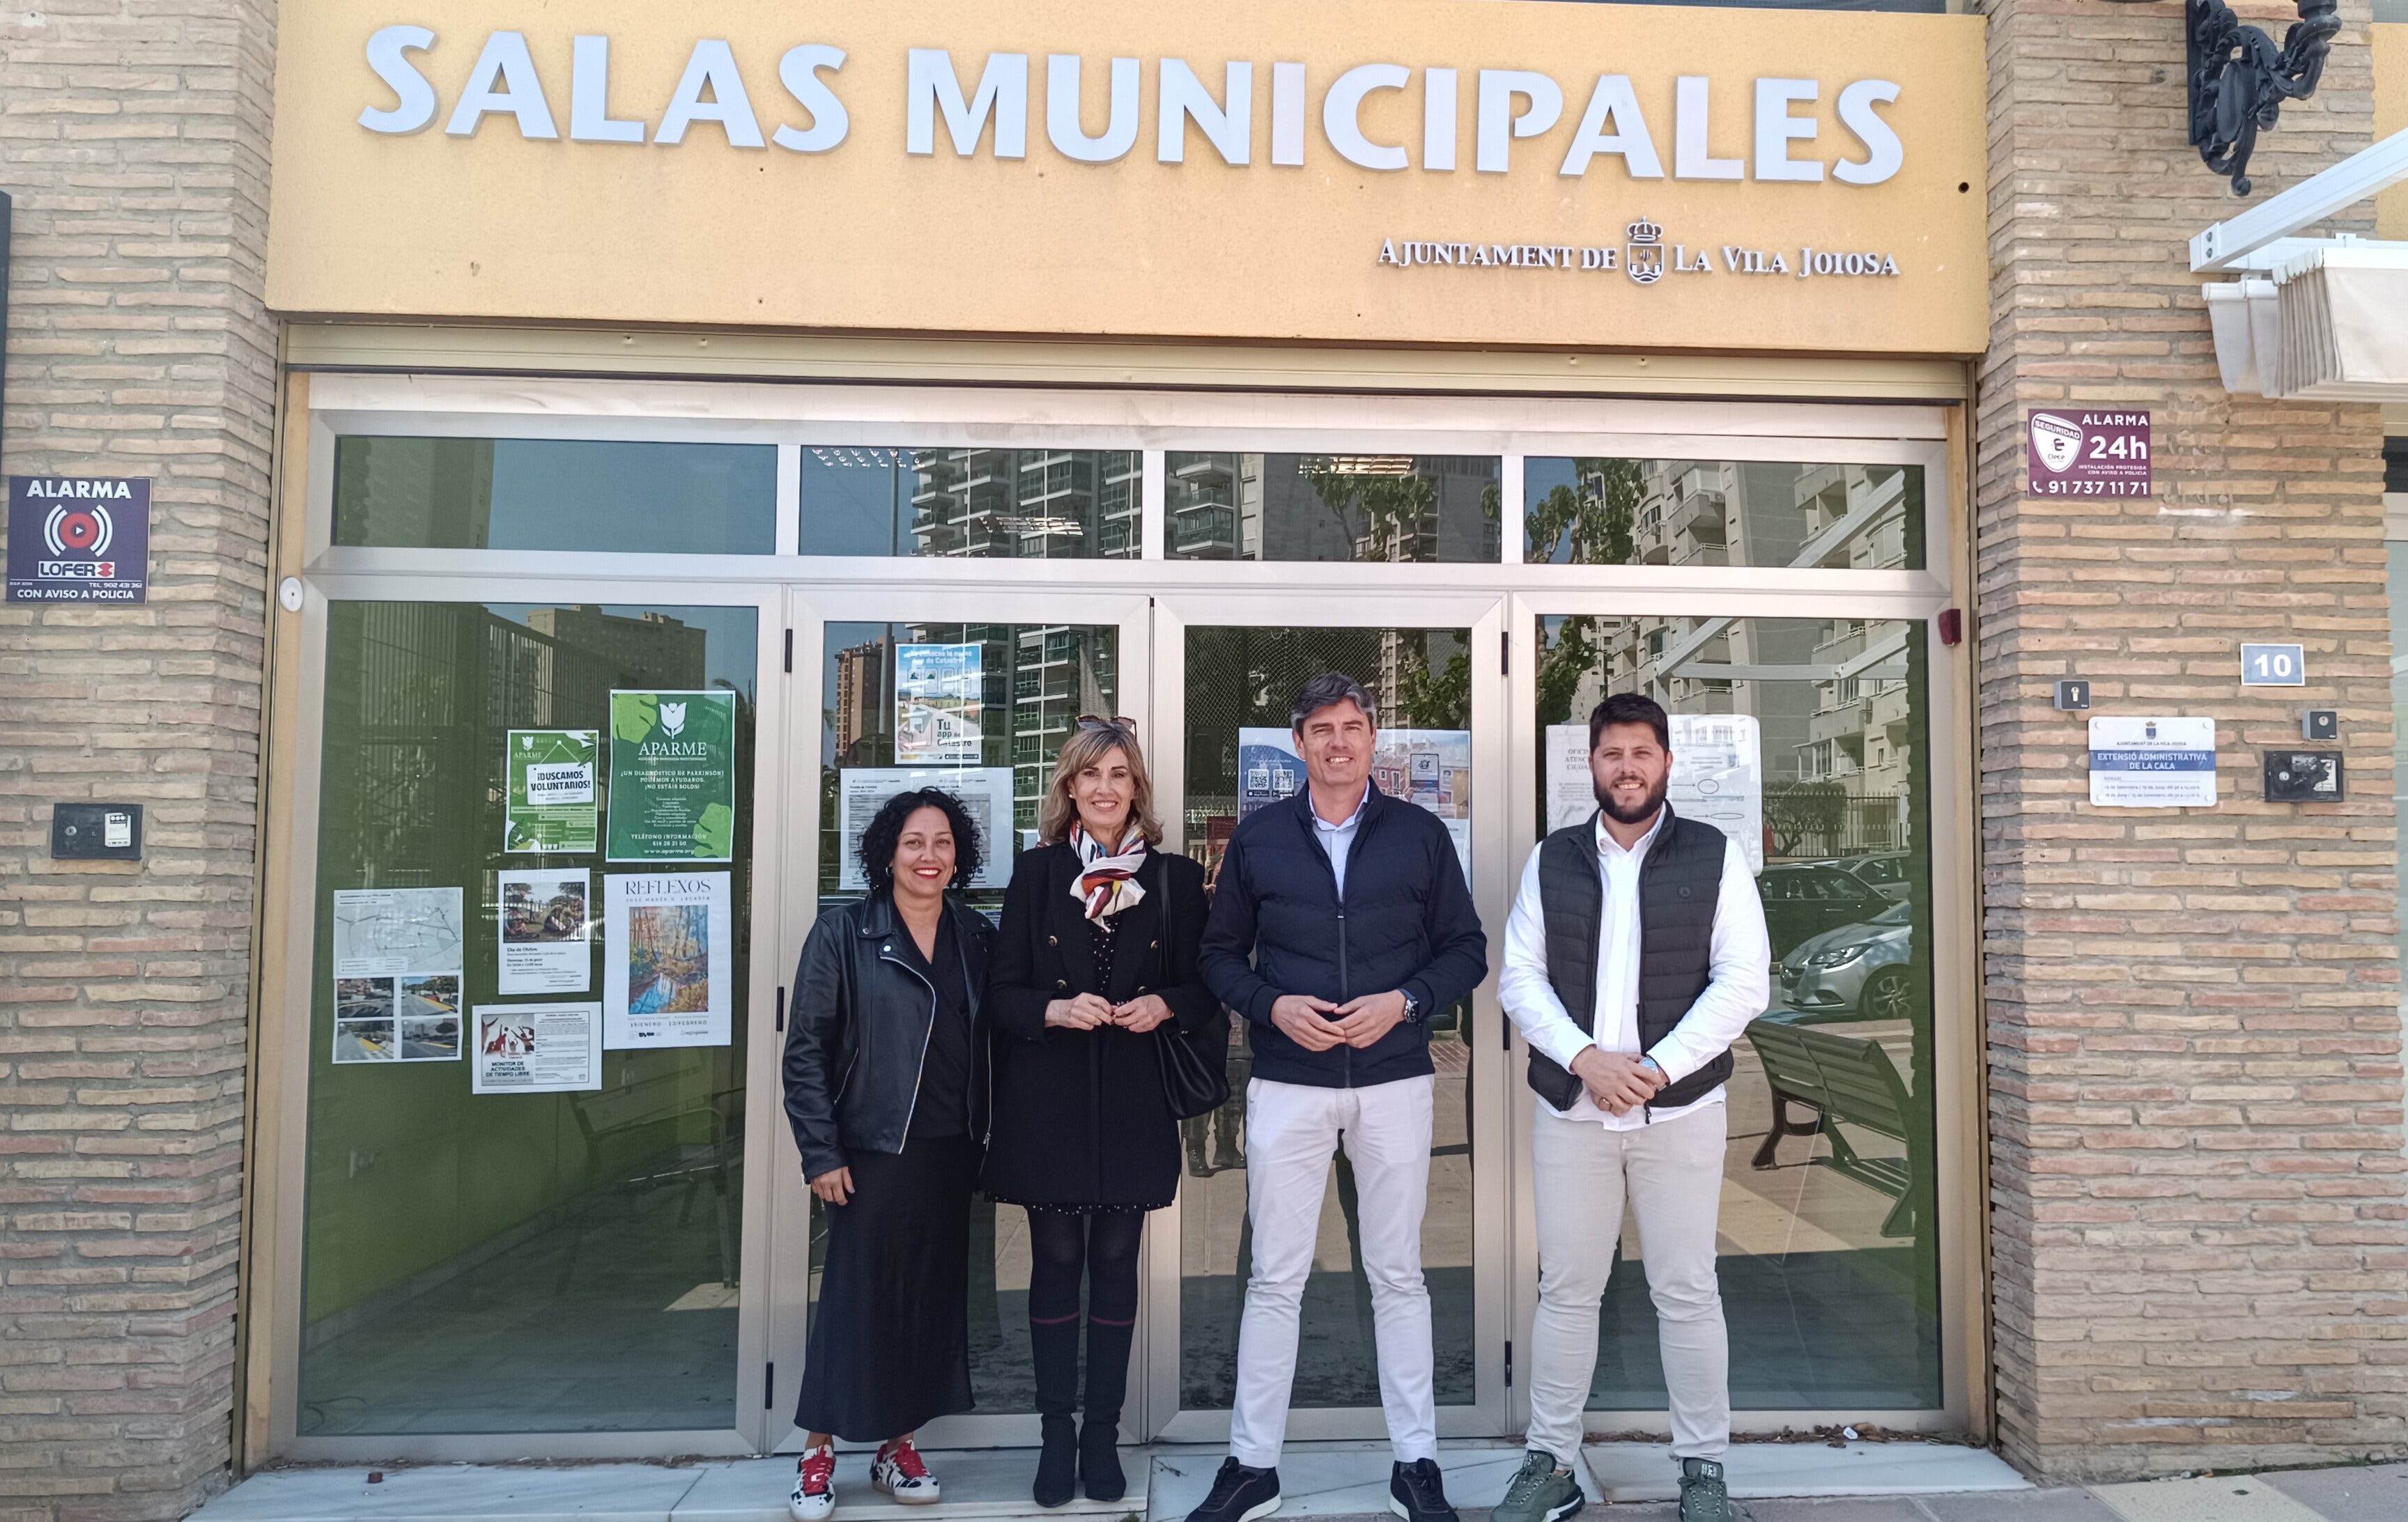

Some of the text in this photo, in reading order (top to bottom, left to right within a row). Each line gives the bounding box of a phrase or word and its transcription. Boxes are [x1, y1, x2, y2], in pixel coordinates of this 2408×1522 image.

[357, 25, 1905, 185] SALAS MUNICIPALES
[1377, 237, 1901, 279] AJUNTAMENT DE LA VILA JOIOSA
[2081, 414, 2149, 426] ALARMA
[2035, 419, 2081, 440] SEGURIDAD
[2089, 435, 2147, 460] 24h
[26, 480, 132, 499] ALARMA
[2048, 481, 2147, 495] 91 737 11 71
[40, 563, 96, 577] LOFER
[17, 589, 134, 599] CON AVISO A POLICIA
[2253, 654, 2292, 677] 10
[936, 718, 951, 731] Tu
[638, 741, 707, 755] APARME
[2097, 752, 2207, 761] EXTENSIÓ ADMINISTRATIVA
[2129, 762, 2175, 770] DE LA CALA
[530, 780, 591, 791] VOLUNTARIOS!
[626, 879, 711, 894] REFLEXOS
